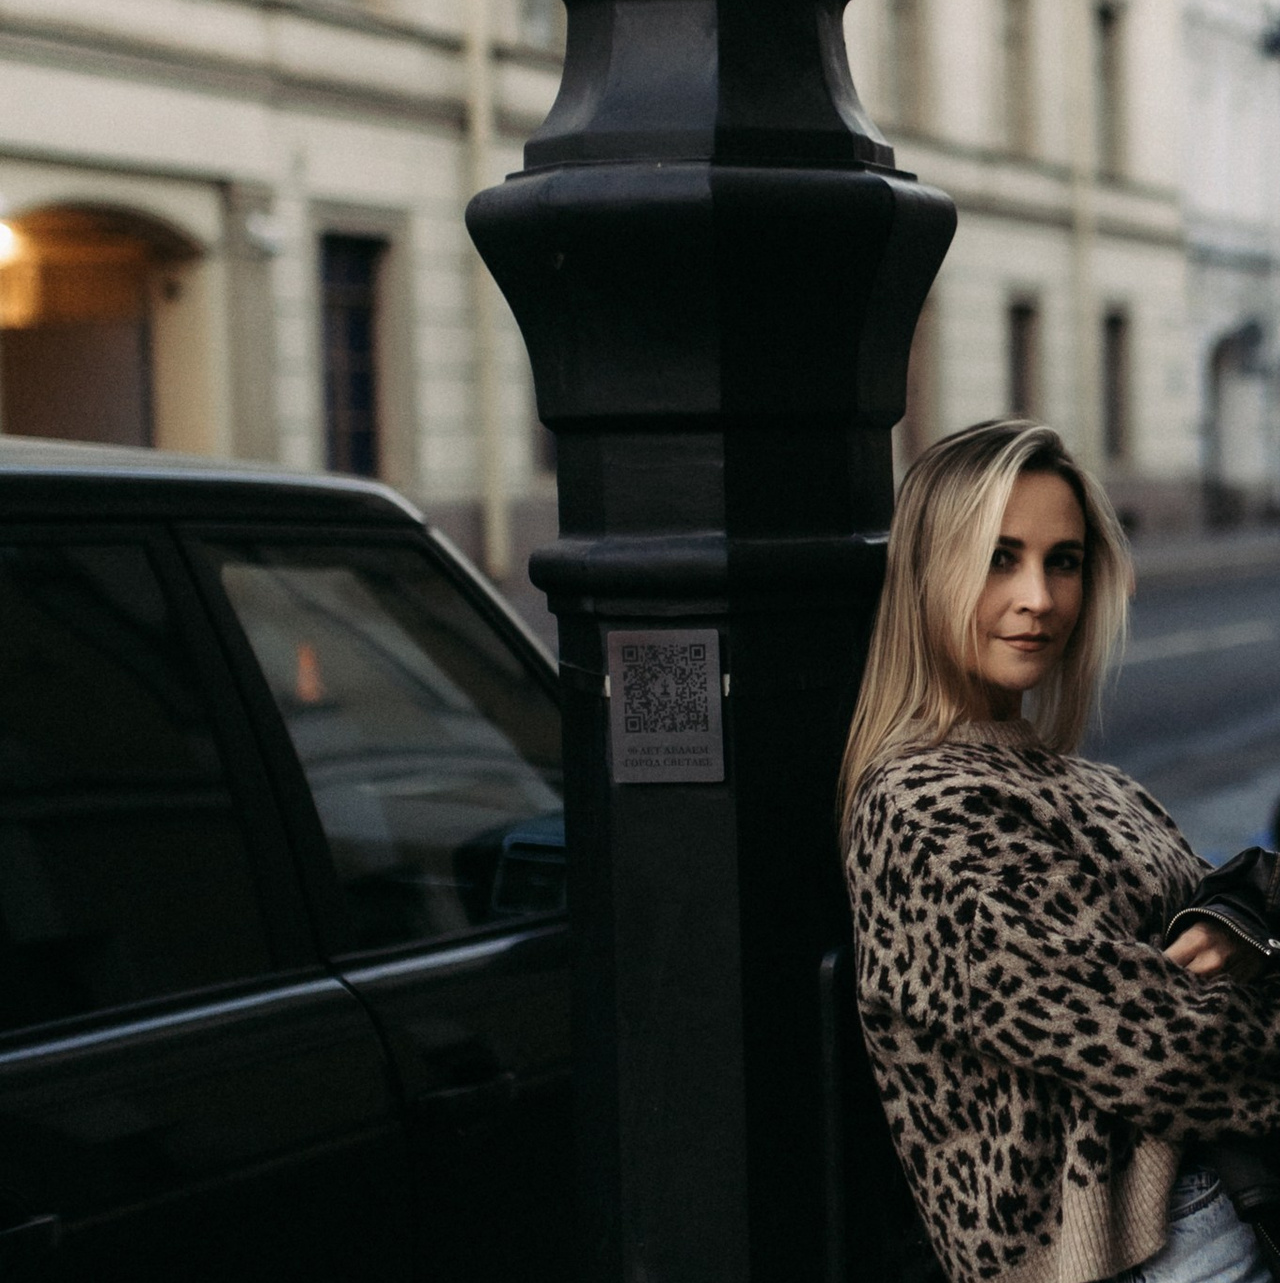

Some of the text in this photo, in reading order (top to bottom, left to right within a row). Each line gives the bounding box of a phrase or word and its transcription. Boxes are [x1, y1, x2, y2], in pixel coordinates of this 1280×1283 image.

[640, 746, 661, 755] ЛЕТ
[623, 758, 713, 767] ГОРОД СВЕТЛЕЕ
